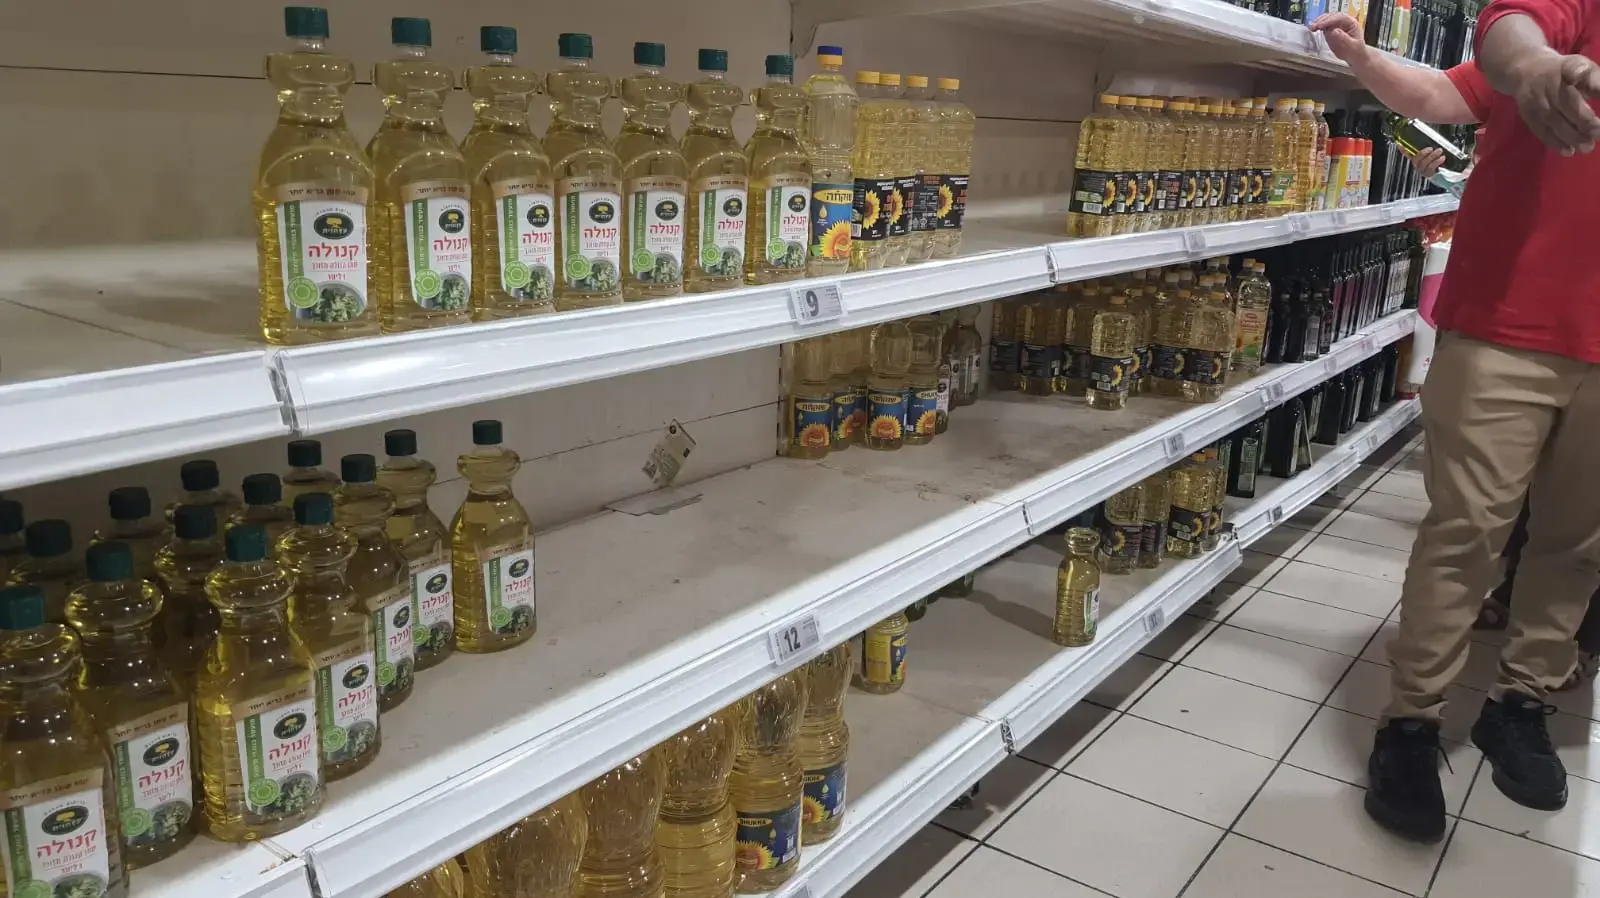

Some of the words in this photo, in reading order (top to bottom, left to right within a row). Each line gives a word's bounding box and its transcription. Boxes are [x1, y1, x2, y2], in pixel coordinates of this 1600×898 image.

[649, 222, 681, 237] קנולה
[718, 219, 744, 232] קנולה
[783, 214, 807, 227] קנולה
[522, 230, 552, 245] קנולה
[584, 225, 617, 240] קנולה
[308, 241, 359, 261] קנולה
[433, 236, 468, 253] קנולה
[806, 291, 819, 317] 9
[505, 576, 532, 593] קנולה
[423, 591, 450, 610] קנולה
[784, 627, 801, 652] 12
[338, 684, 373, 709] קנולה
[268, 733, 311, 760] קנולה
[137, 759, 185, 788] קנולה
[36, 829, 98, 860] קנולה
